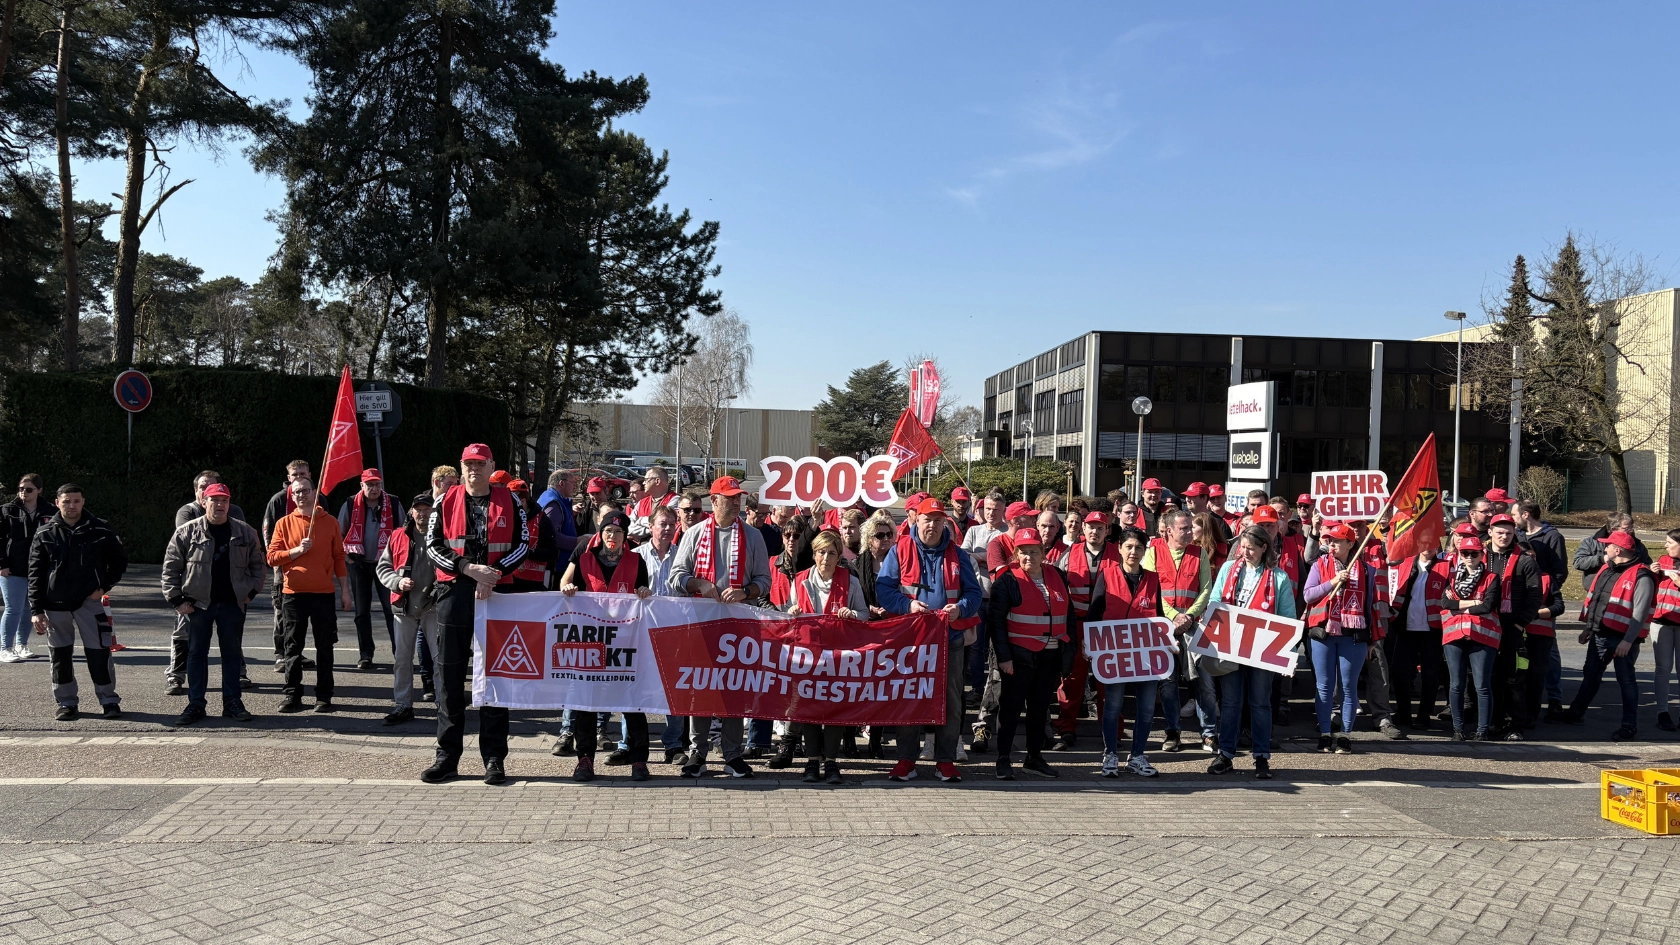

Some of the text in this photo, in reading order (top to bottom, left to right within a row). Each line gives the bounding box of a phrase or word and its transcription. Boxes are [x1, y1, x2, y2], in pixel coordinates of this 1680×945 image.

[372, 402, 388, 410] StVO
[376, 394, 386, 402] gilt
[765, 460, 892, 502] 200€
[1314, 474, 1384, 495] MEHR
[1320, 496, 1381, 517] GELD
[426, 511, 438, 547] adidas
[519, 508, 530, 541] adidas
[554, 624, 618, 645] TARIF
[1089, 621, 1172, 651] MEHR
[1197, 608, 1297, 668] ATZ
[556, 647, 637, 667] WIRKT
[716, 633, 939, 678] SOLIDARISCH
[1097, 650, 1170, 679] GELD
[551, 672, 577, 681] TEXTIL
[675, 667, 935, 703] ZUKUNFT GESTALTEN
